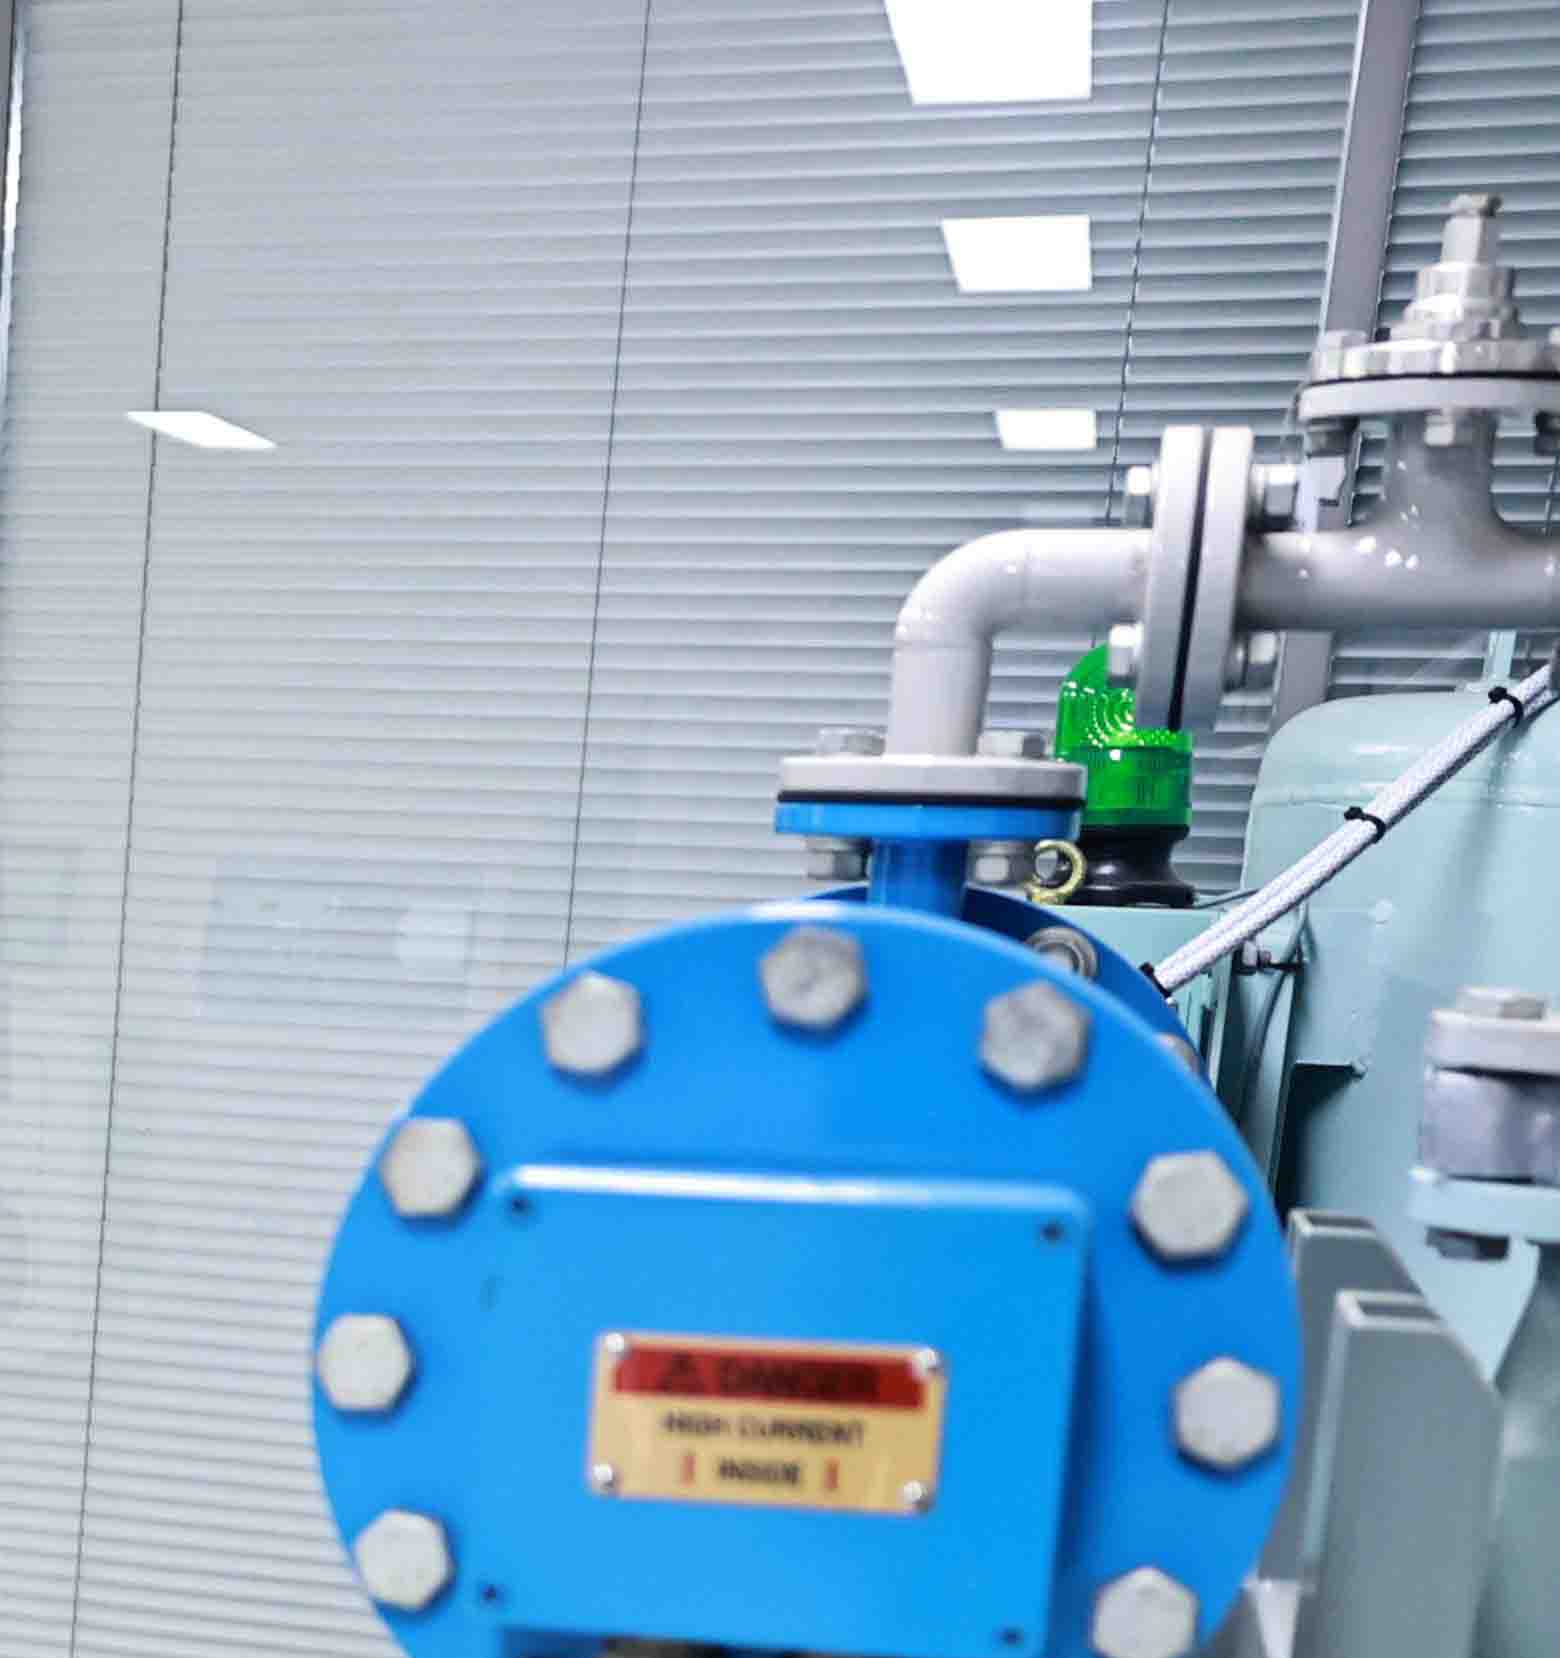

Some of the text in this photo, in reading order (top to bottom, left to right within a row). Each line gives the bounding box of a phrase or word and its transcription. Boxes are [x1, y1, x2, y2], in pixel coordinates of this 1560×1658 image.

[718, 1355, 880, 1399] DANGER
[662, 1411, 864, 1447] HIGH CURRENT
[717, 1457, 801, 1487] INSIDE
